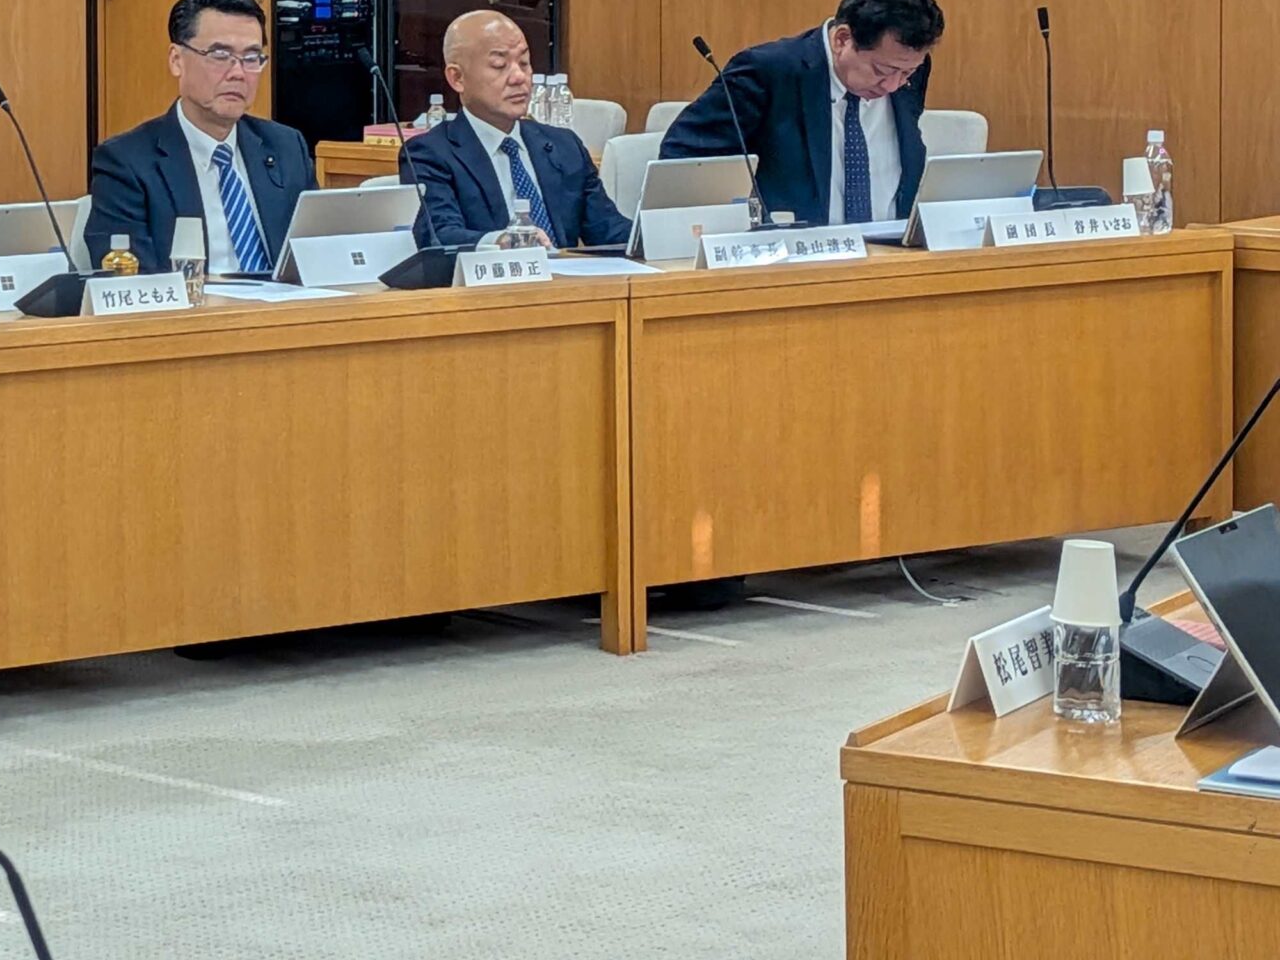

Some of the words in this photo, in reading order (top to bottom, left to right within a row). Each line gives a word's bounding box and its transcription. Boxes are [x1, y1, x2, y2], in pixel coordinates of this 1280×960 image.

[102, 286, 179, 308] 竹尾ともえ
